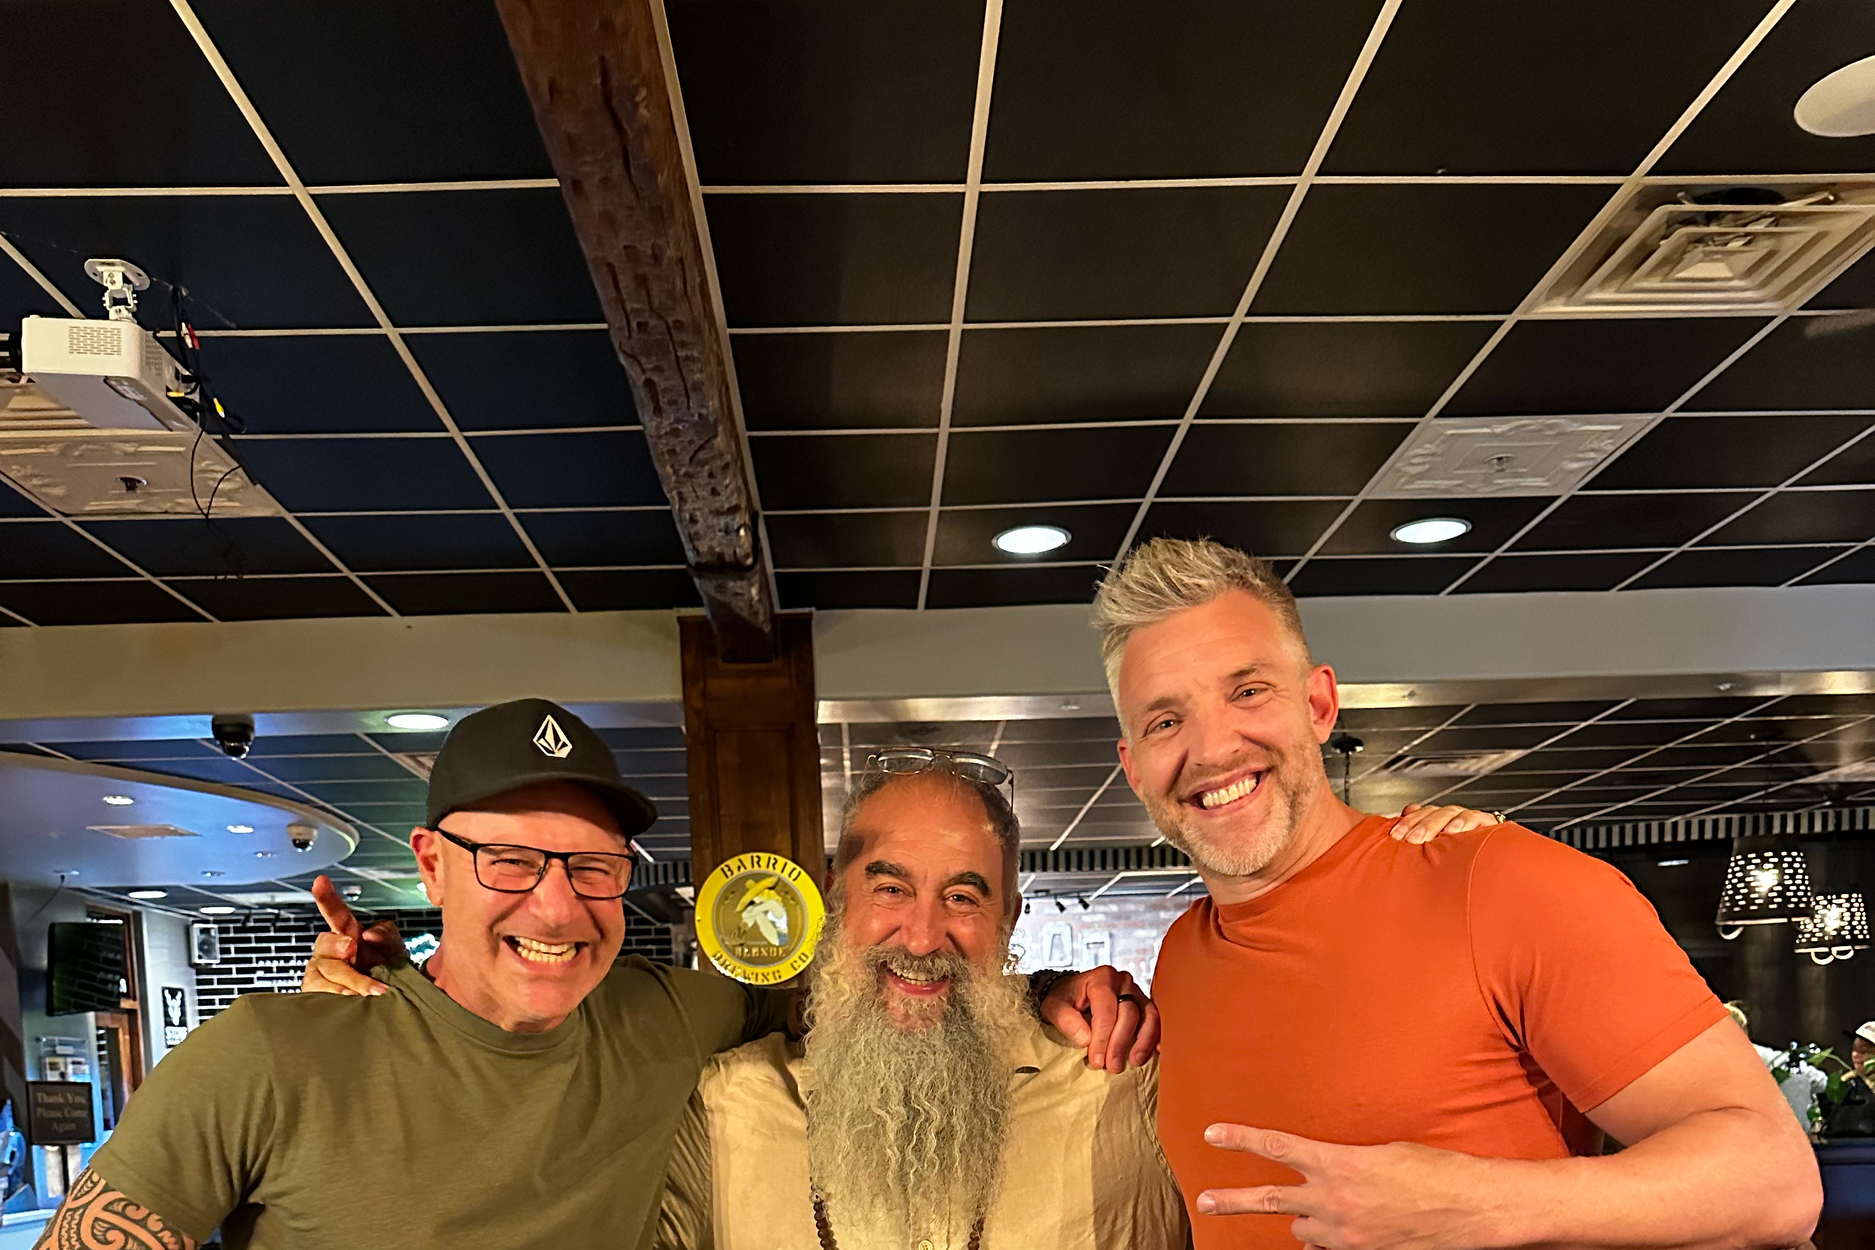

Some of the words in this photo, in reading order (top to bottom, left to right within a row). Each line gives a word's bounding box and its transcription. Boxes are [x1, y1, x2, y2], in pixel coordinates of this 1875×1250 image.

[720, 855, 802, 881] BARRIO
[712, 951, 782, 983] BREWING
[36, 1092, 64, 1104] Thank
